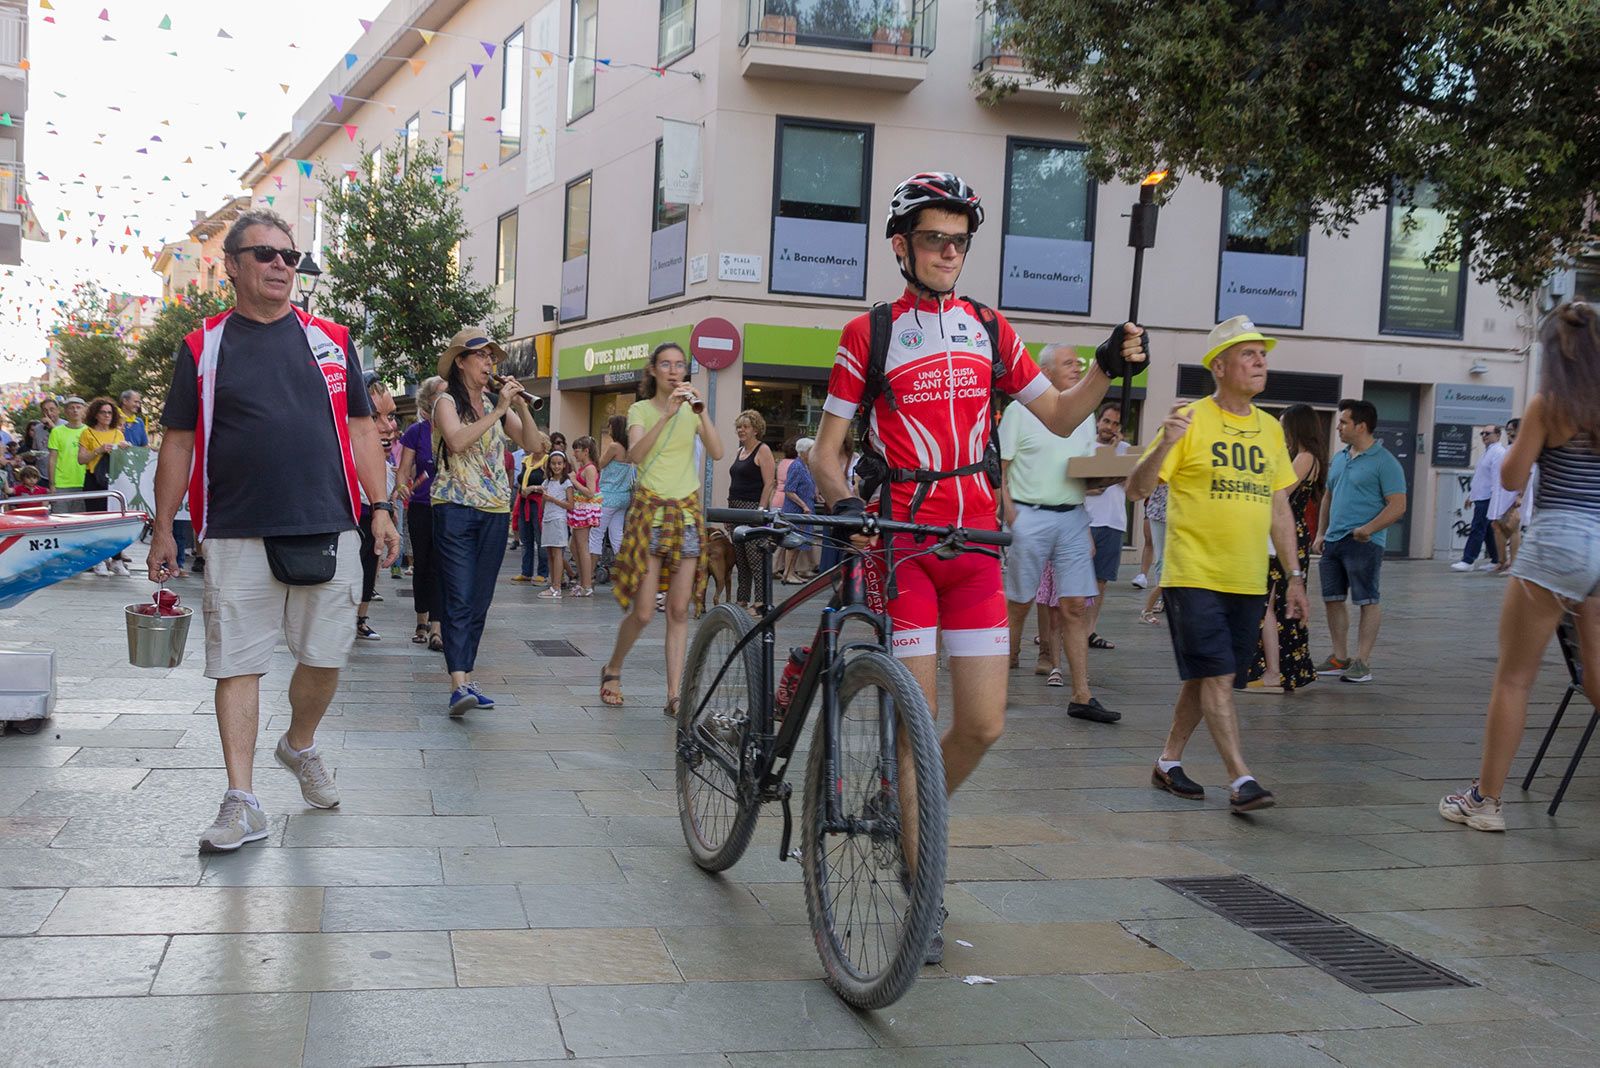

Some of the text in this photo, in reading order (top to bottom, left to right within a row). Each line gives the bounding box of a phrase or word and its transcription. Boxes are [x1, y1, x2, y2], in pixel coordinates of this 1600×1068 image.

[794, 252, 858, 267] BancaMarch
[1023, 270, 1083, 283] BancaMarch
[1240, 285, 1297, 297] BancaMarch
[594, 344, 649, 365] YVES ROCHER
[918, 368, 975, 380] UNIÓ CCLISTA
[913, 379, 942, 391] SANT
[902, 391, 941, 404] ESCOLA
[1456, 392, 1506, 403] BancaMarch
[1212, 441, 1265, 475] SOC
[29, 538, 60, 551] N-21
[892, 637, 920, 647] UGAT
